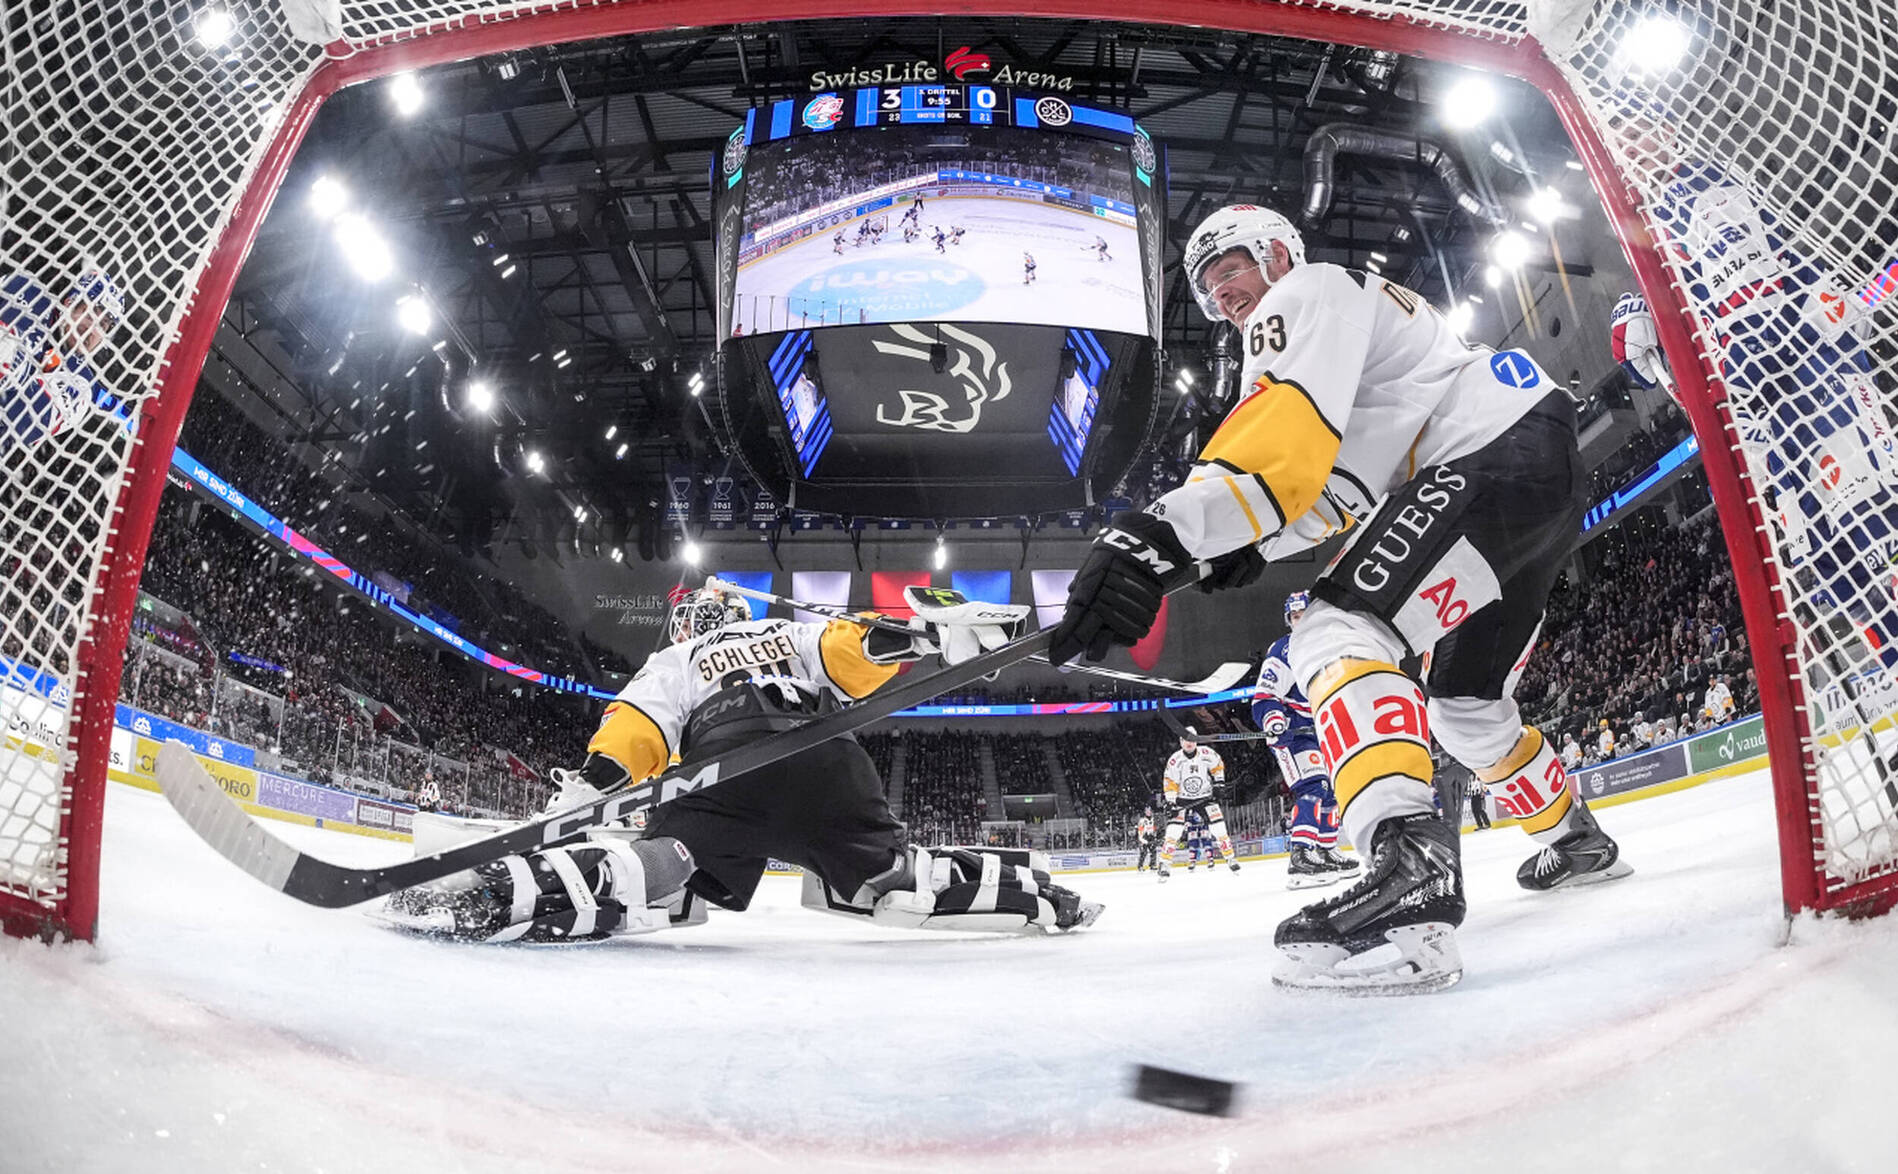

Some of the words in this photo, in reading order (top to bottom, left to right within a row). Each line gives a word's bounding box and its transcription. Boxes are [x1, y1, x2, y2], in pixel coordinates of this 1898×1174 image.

[809, 60, 938, 91] SwissLife
[991, 64, 1074, 91] Arena
[881, 89, 901, 109] 3
[976, 89, 996, 108] 0
[809, 270, 968, 292] iway
[1250, 313, 1287, 356] 63
[669, 502, 690, 510] 1960
[713, 502, 731, 510] 1961
[754, 502, 775, 510] 2016
[1353, 465, 1467, 592] GUESS
[617, 611, 664, 625] Arena
[261, 777, 327, 804] MERCURE
[543, 761, 720, 844] CCM
